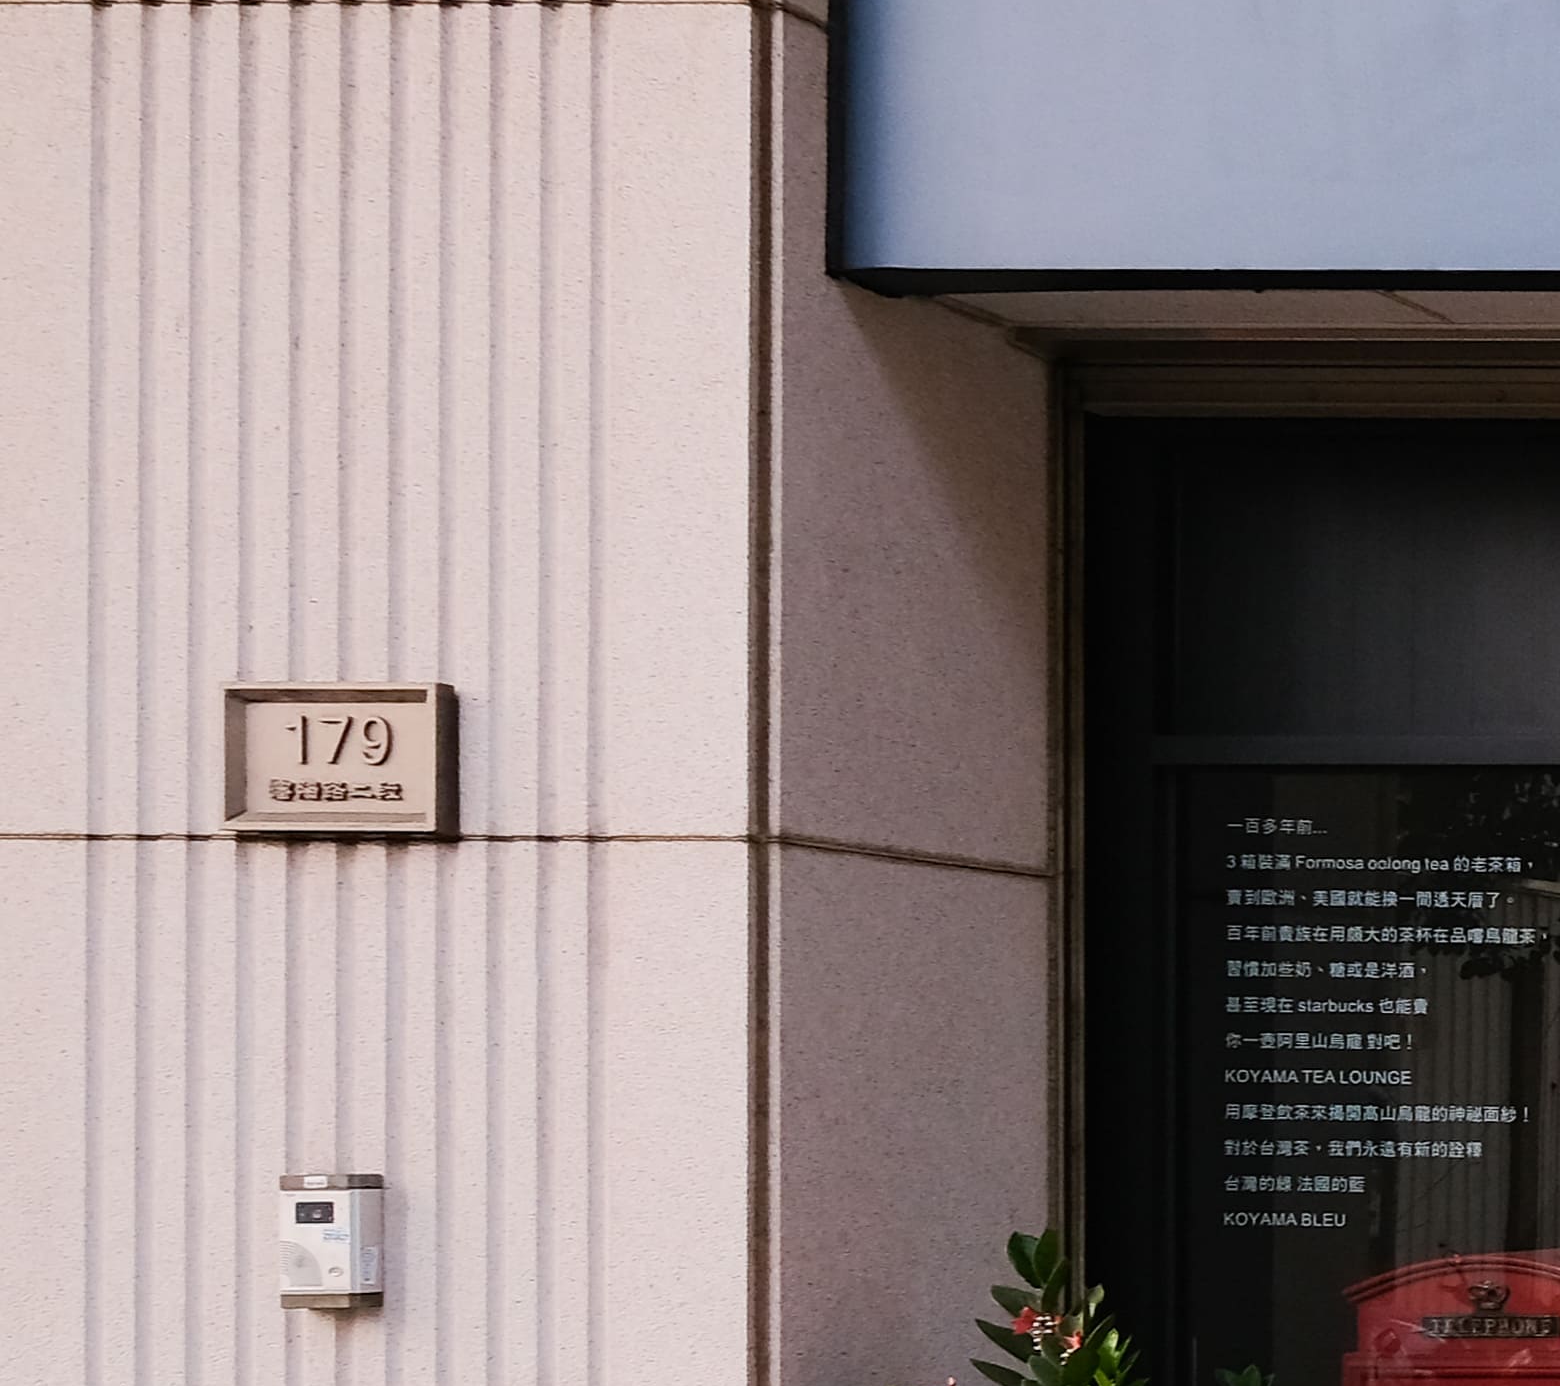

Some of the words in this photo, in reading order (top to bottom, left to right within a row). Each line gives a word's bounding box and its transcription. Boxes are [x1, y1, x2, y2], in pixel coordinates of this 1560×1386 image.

[285, 714, 395, 766] 179
[1226, 855, 1236, 870] 3
[1295, 855, 1364, 871] Formosa
[1425, 857, 1449, 872] tea
[1225, 995, 1294, 1014] 甚至現在
[1297, 997, 1374, 1013] starbucks
[1224, 1069, 1299, 1085] KOYAMA
[1302, 1070, 1336, 1085] TEA
[1339, 1070, 1413, 1086] LOUNGE
[1223, 1212, 1297, 1227] KOYAMA
[1301, 1213, 1347, 1227] BLEU
